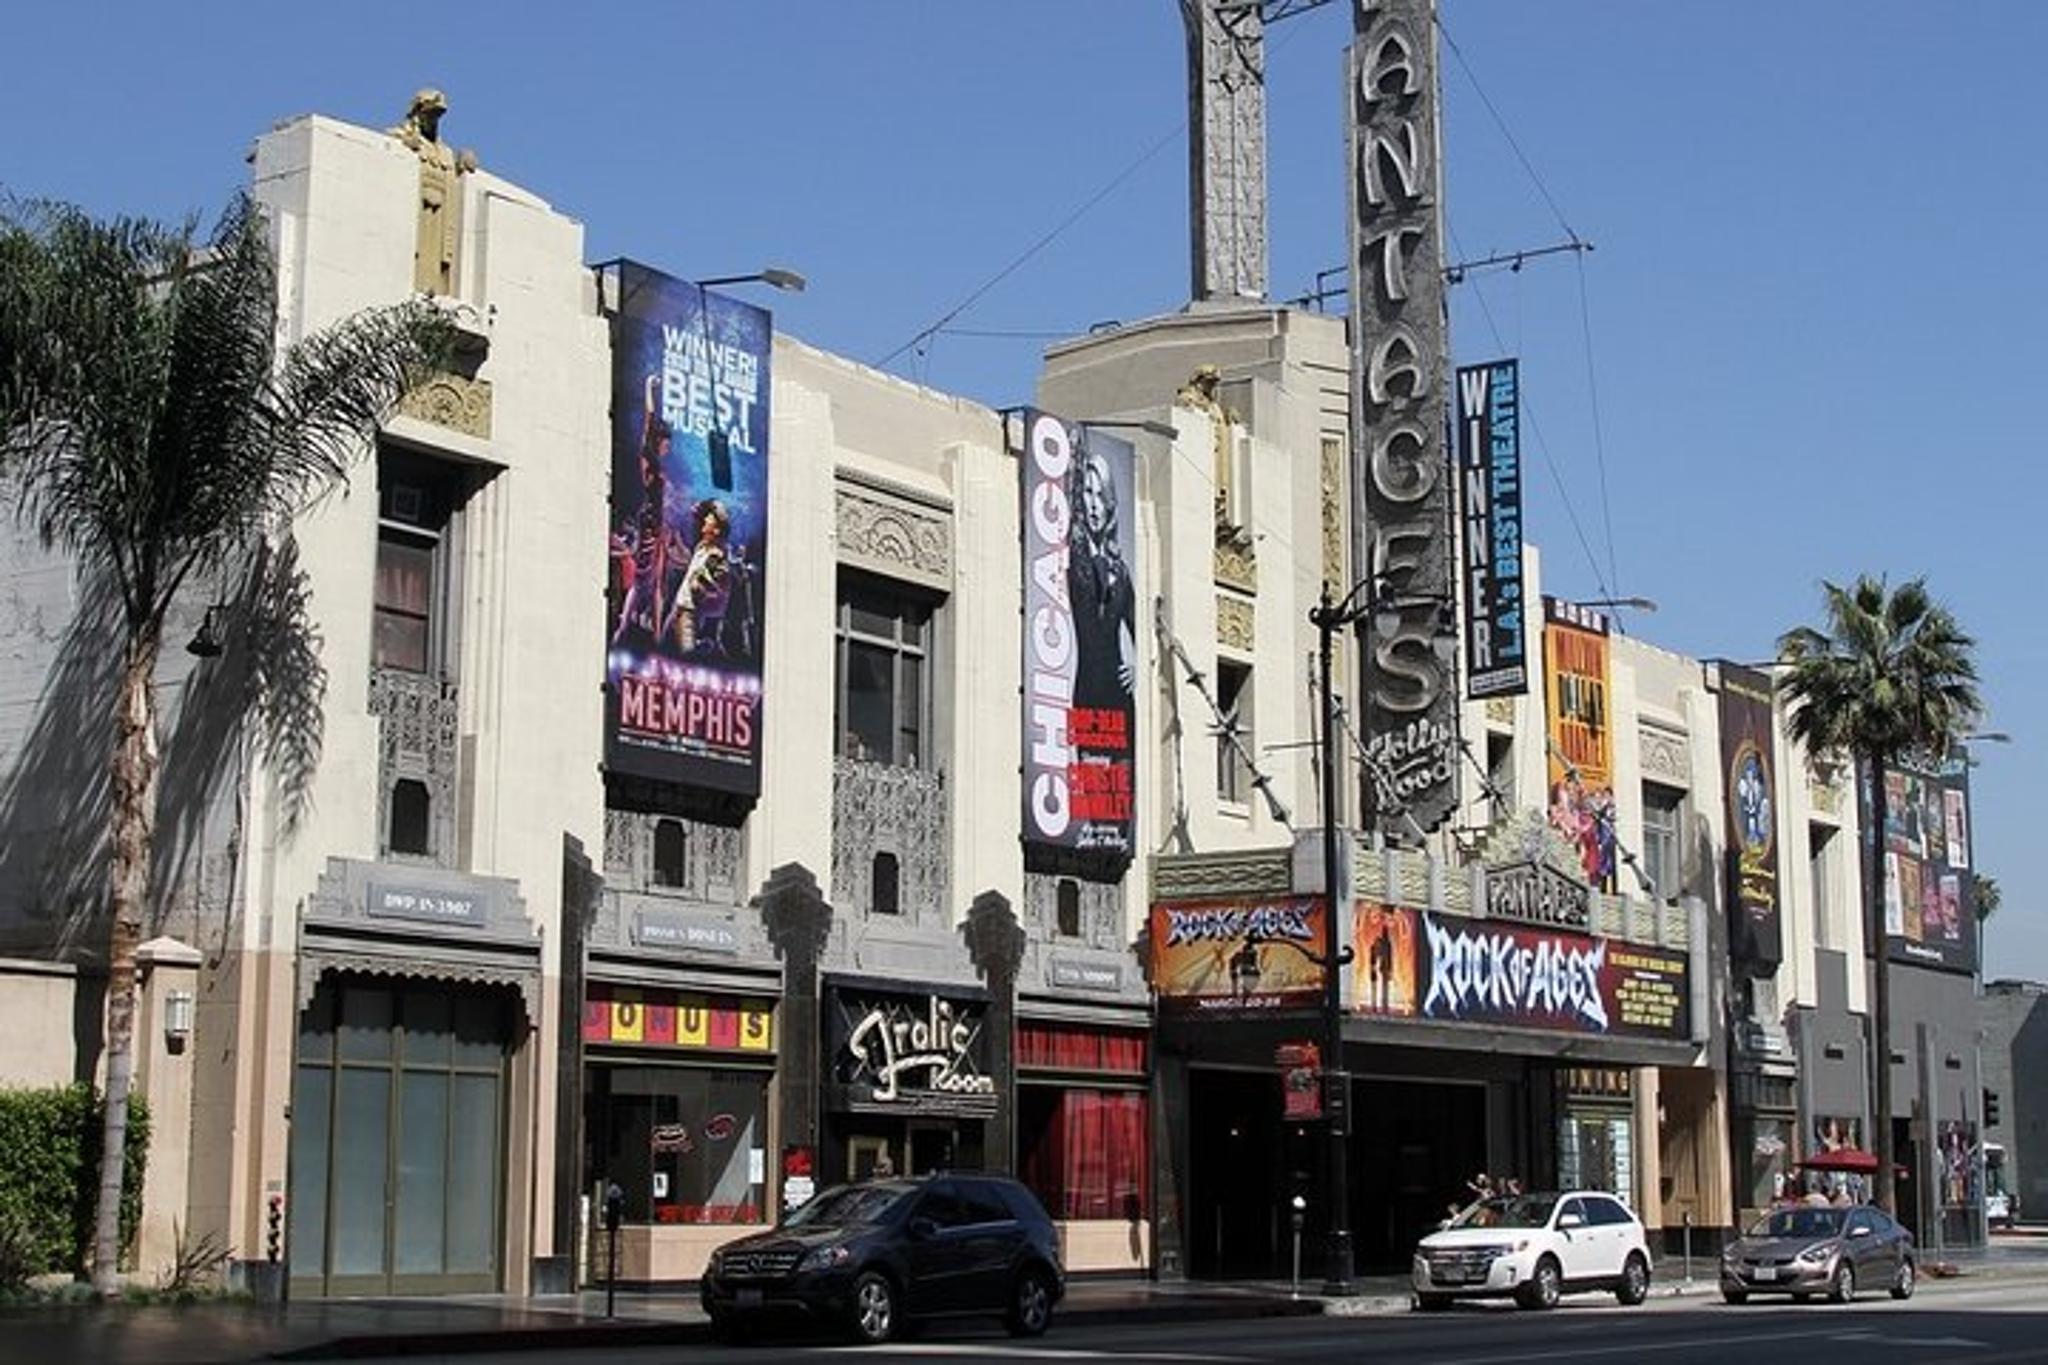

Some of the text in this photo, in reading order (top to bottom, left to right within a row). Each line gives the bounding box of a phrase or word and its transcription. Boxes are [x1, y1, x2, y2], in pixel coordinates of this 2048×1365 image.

[662, 324, 758, 372] WINNER!
[1361, 0, 1442, 712] ANTAGES
[662, 367, 757, 430] BEST
[1490, 366, 1518, 499] THEATRE
[1461, 370, 1492, 669] WINNER
[1493, 502, 1520, 580] BEST
[1031, 415, 1072, 838] CHICAGO
[621, 679, 753, 747] MEMPHIS
[1166, 907, 1235, 946] ROCK
[1245, 900, 1315, 940] AGES
[1422, 910, 1516, 1019] ROCK
[1510, 949, 1533, 995] OF
[1527, 934, 1610, 1034] AGES
[849, 995, 972, 1100] Frolic
[892, 1053, 995, 1094] Room
